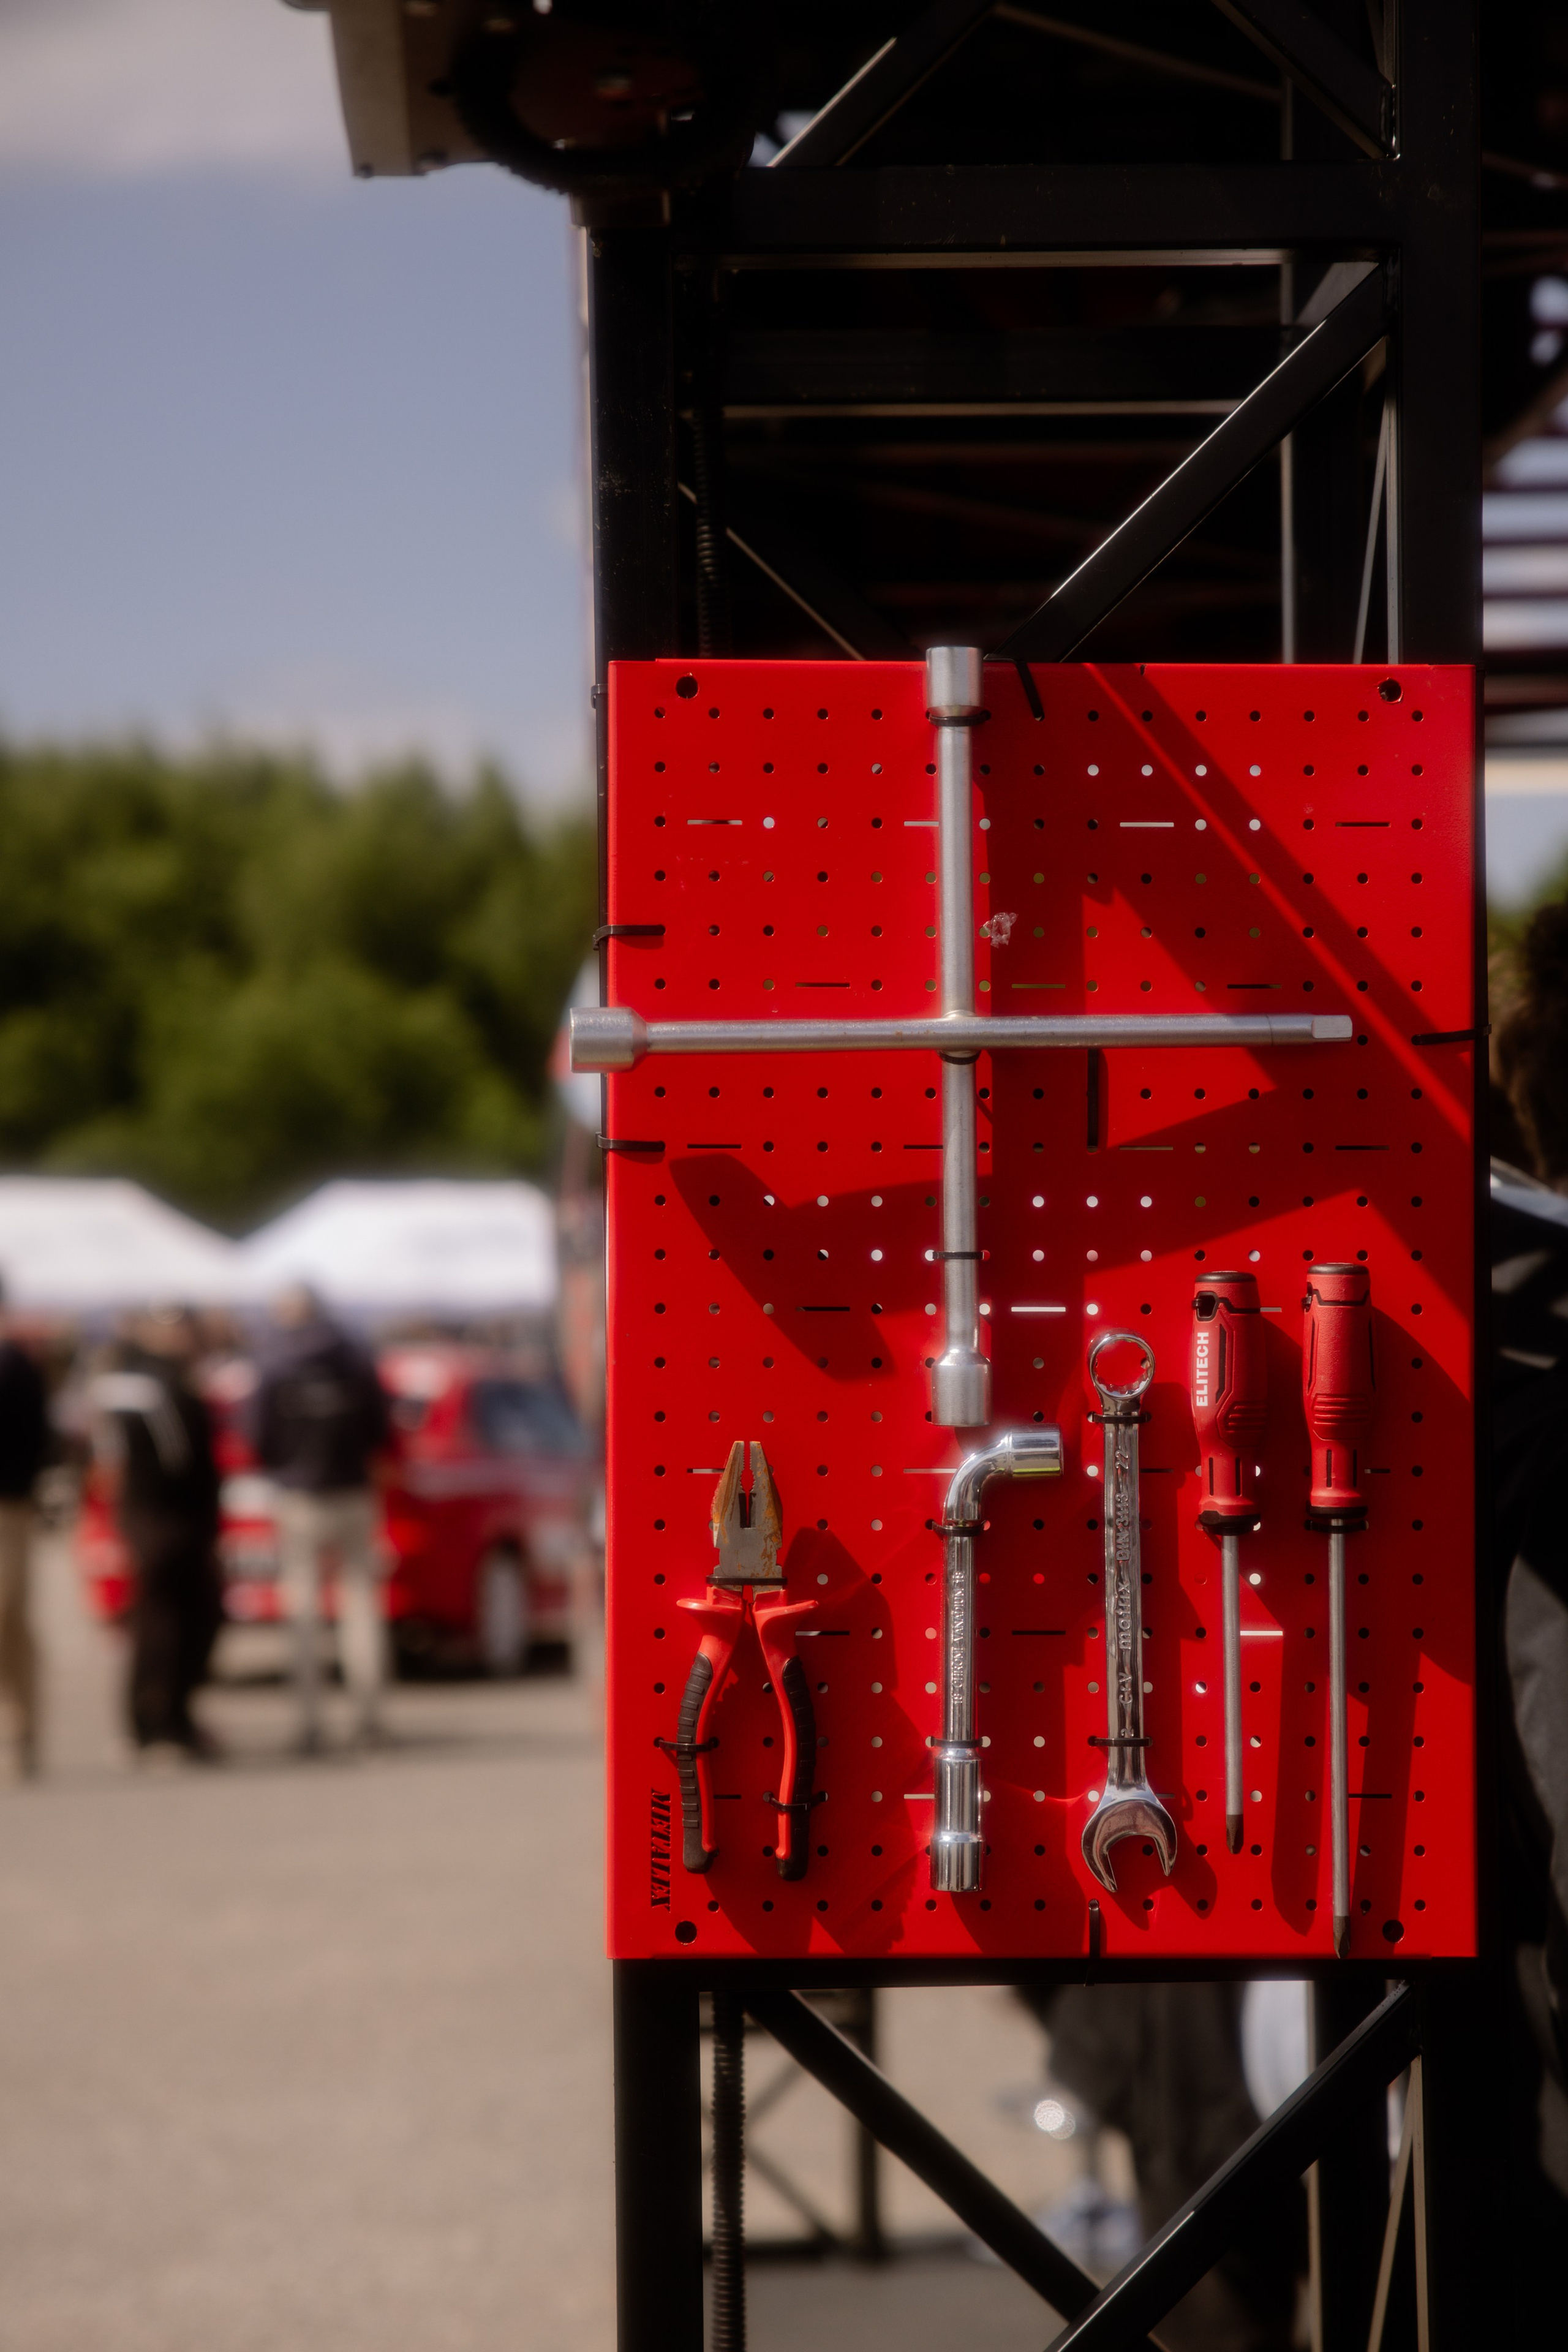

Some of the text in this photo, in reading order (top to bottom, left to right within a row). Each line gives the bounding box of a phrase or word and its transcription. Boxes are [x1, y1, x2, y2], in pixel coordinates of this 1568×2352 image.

[1196, 1332, 1209, 1407] ELITECH
[1115, 1450, 1129, 1469] 22
[1115, 1493, 1129, 1526] 3113
[1116, 1532, 1130, 1561] DIN
[953, 1588, 965, 1642] VANADIUM
[1114, 1581, 1131, 1650] matrix
[1118, 1672, 1133, 1705] CrV
[650, 1787, 672, 1913] METALEX
